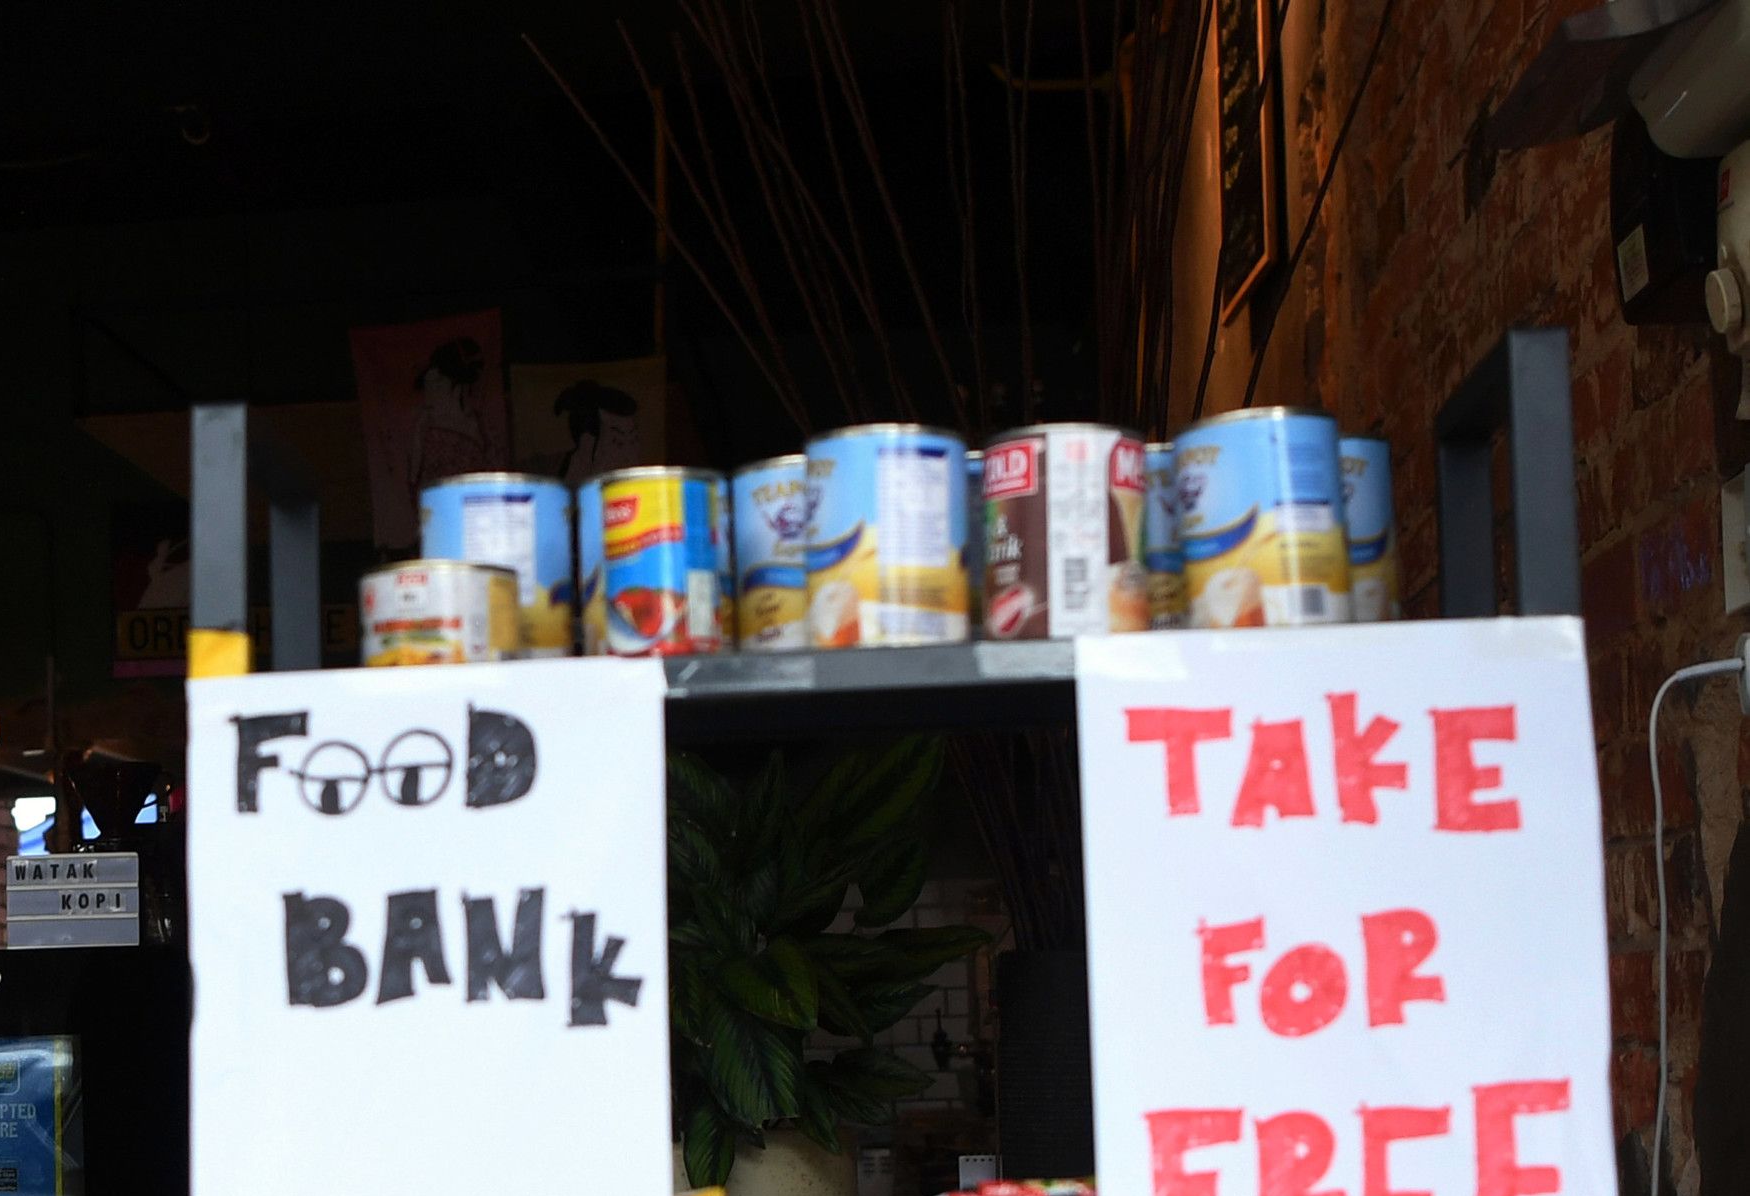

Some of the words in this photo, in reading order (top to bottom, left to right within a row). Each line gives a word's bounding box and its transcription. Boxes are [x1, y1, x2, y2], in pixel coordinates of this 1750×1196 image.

[228, 702, 537, 816] FOOD
[15, 863, 94, 880] WATAK
[61, 893, 121, 910] KOPI
[1195, 908, 1446, 1038] FOR
